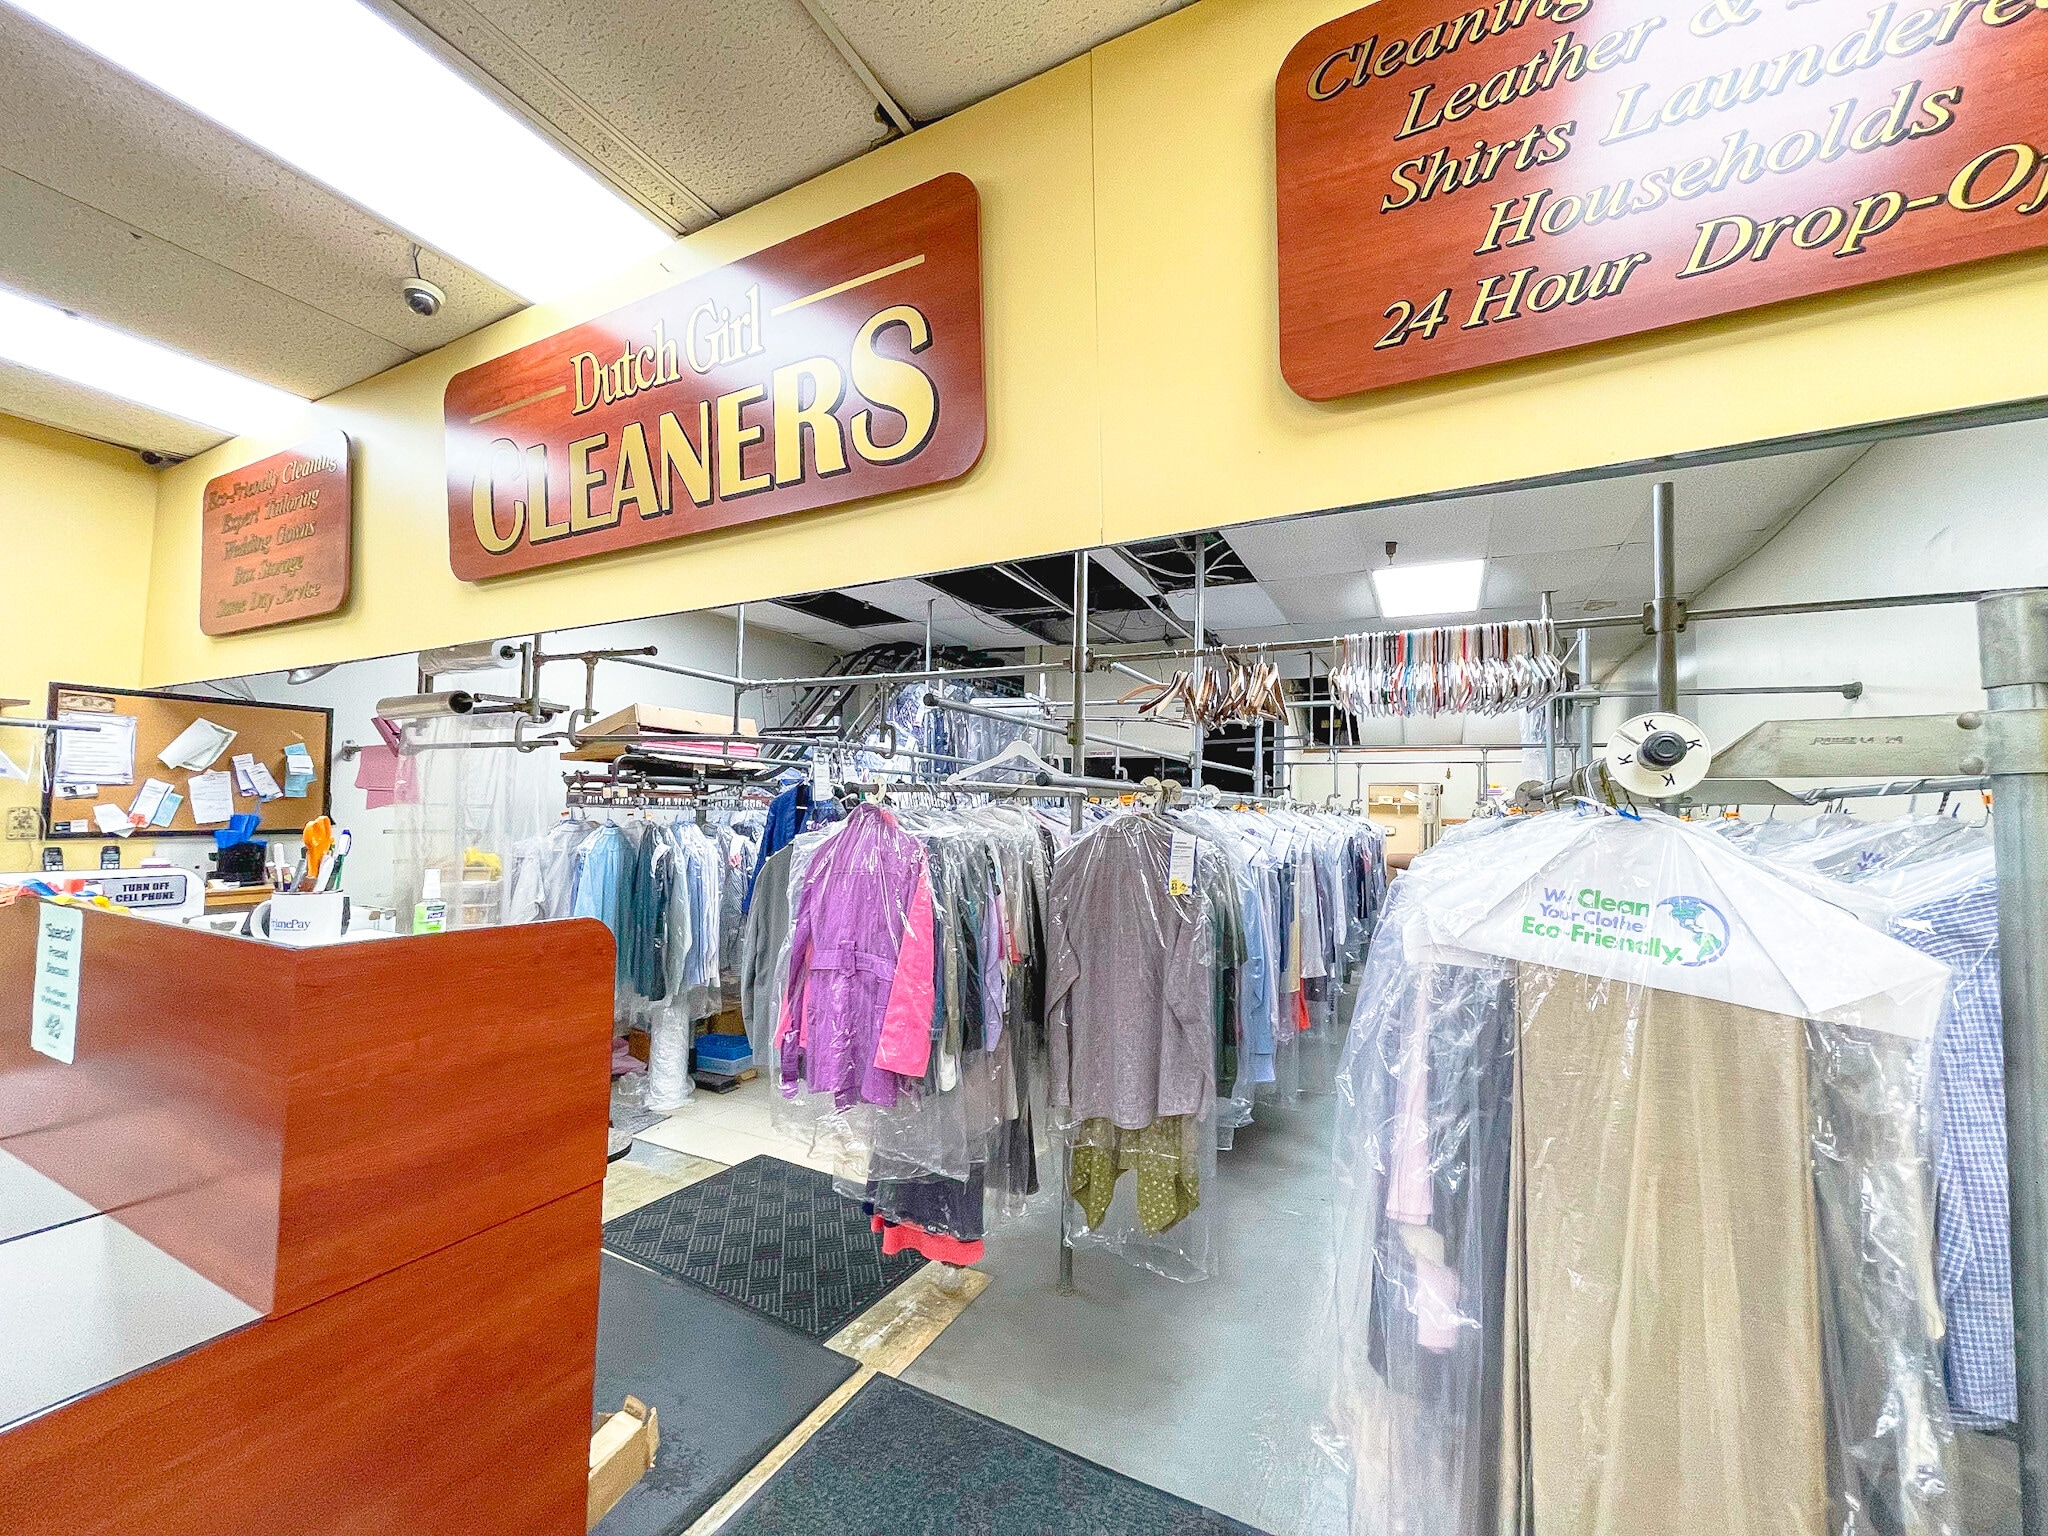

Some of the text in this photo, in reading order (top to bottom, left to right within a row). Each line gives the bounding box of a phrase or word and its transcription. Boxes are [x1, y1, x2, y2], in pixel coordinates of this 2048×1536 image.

[1394, 15, 1667, 141] Leather
[1380, 0, 2048, 212] Shirts Laundere
[1474, 80, 1963, 254] Households
[1373, 288, 1448, 351] 24
[1461, 249, 1651, 331] Hour
[570, 283, 764, 416] Dutch Girl
[471, 304, 939, 555] CLEANERS
[282, 455, 338, 484] Cleaning
[277, 520, 317, 546] Gowns
[258, 555, 304, 578] Storage
[276, 581, 321, 605] Service
[1644, 719, 1657, 732] K
[1686, 739, 1702, 751] K
[1617, 754, 1634, 765] K
[1661, 773, 1675, 787] K
[115, 891, 174, 902] CELL PHONE
[122, 881, 169, 892] TURN OFF
[1539, 903, 1581, 922] Your
[1577, 888, 1650, 917] Clean
[271, 919, 311, 931] rimePay
